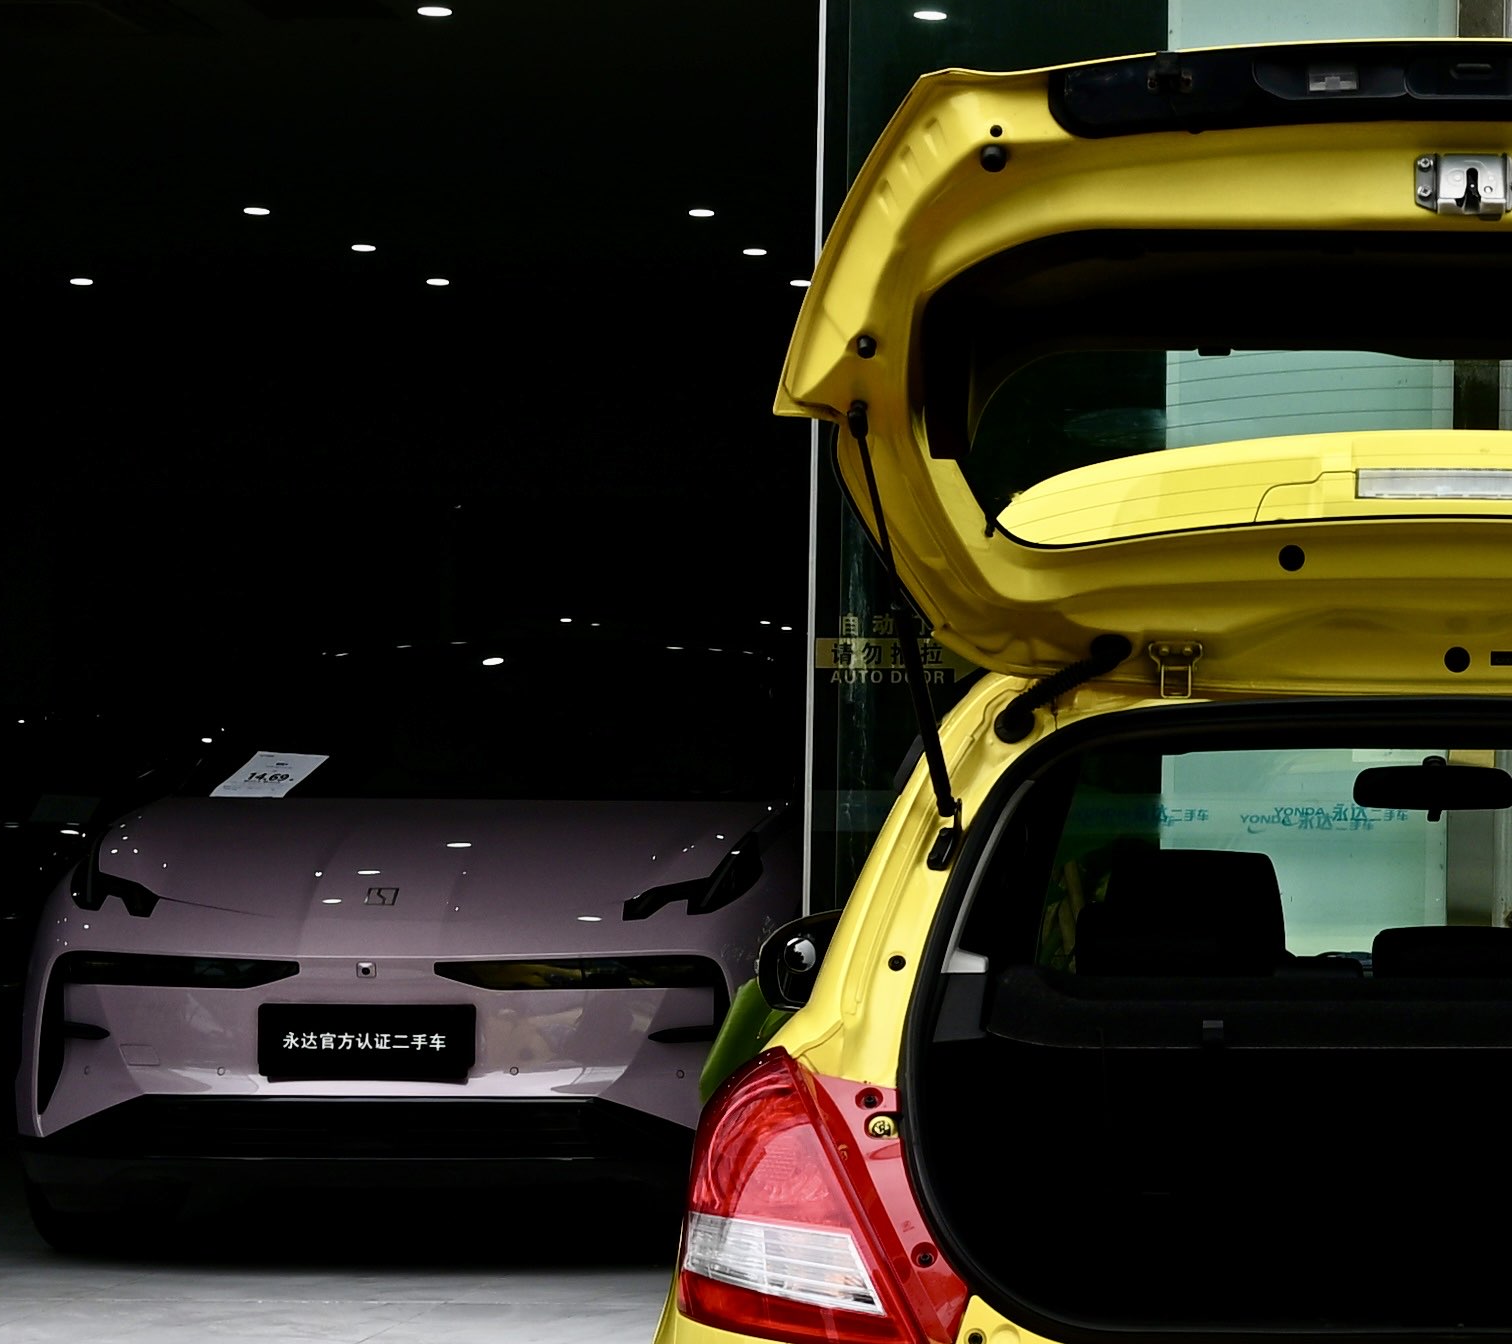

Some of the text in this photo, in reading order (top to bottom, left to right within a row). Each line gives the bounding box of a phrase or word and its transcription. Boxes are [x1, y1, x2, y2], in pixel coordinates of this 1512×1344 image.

[830, 670, 883, 684] AUTO
[1274, 807, 1326, 816] YONDA
[282, 1031, 447, 1052] 永达官方认证二手车
